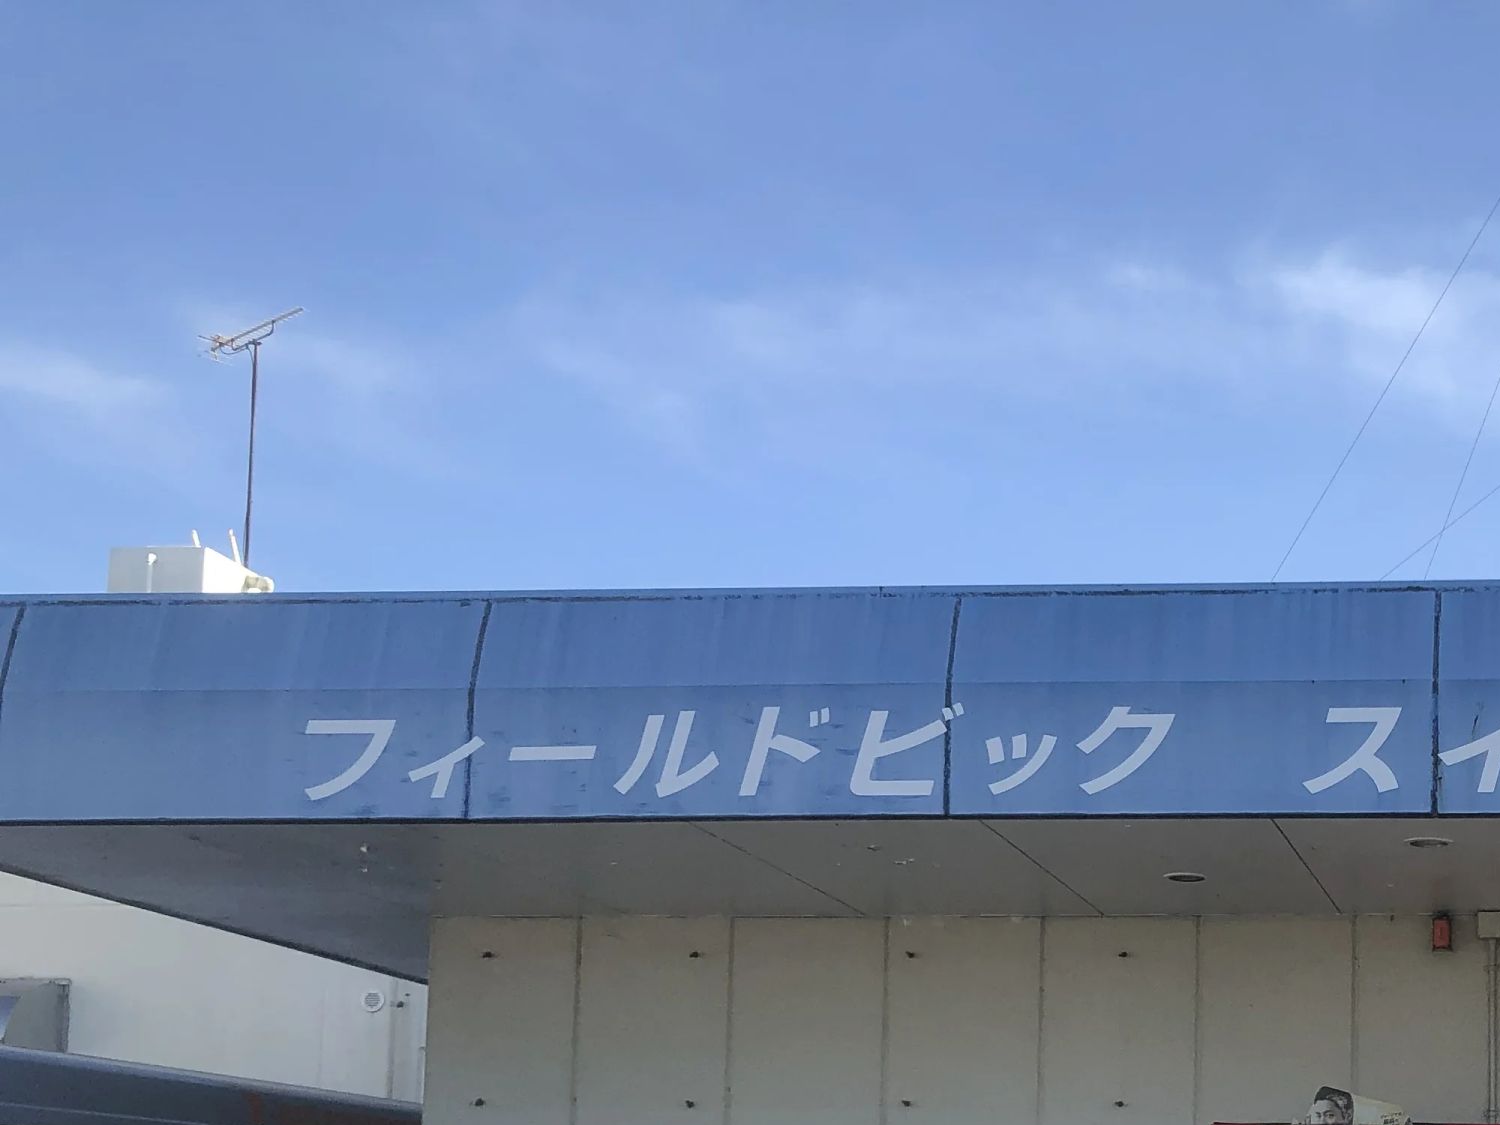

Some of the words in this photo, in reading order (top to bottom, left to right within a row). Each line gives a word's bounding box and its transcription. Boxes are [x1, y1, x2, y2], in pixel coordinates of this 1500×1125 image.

[304, 702, 1176, 801] フィールドビック
